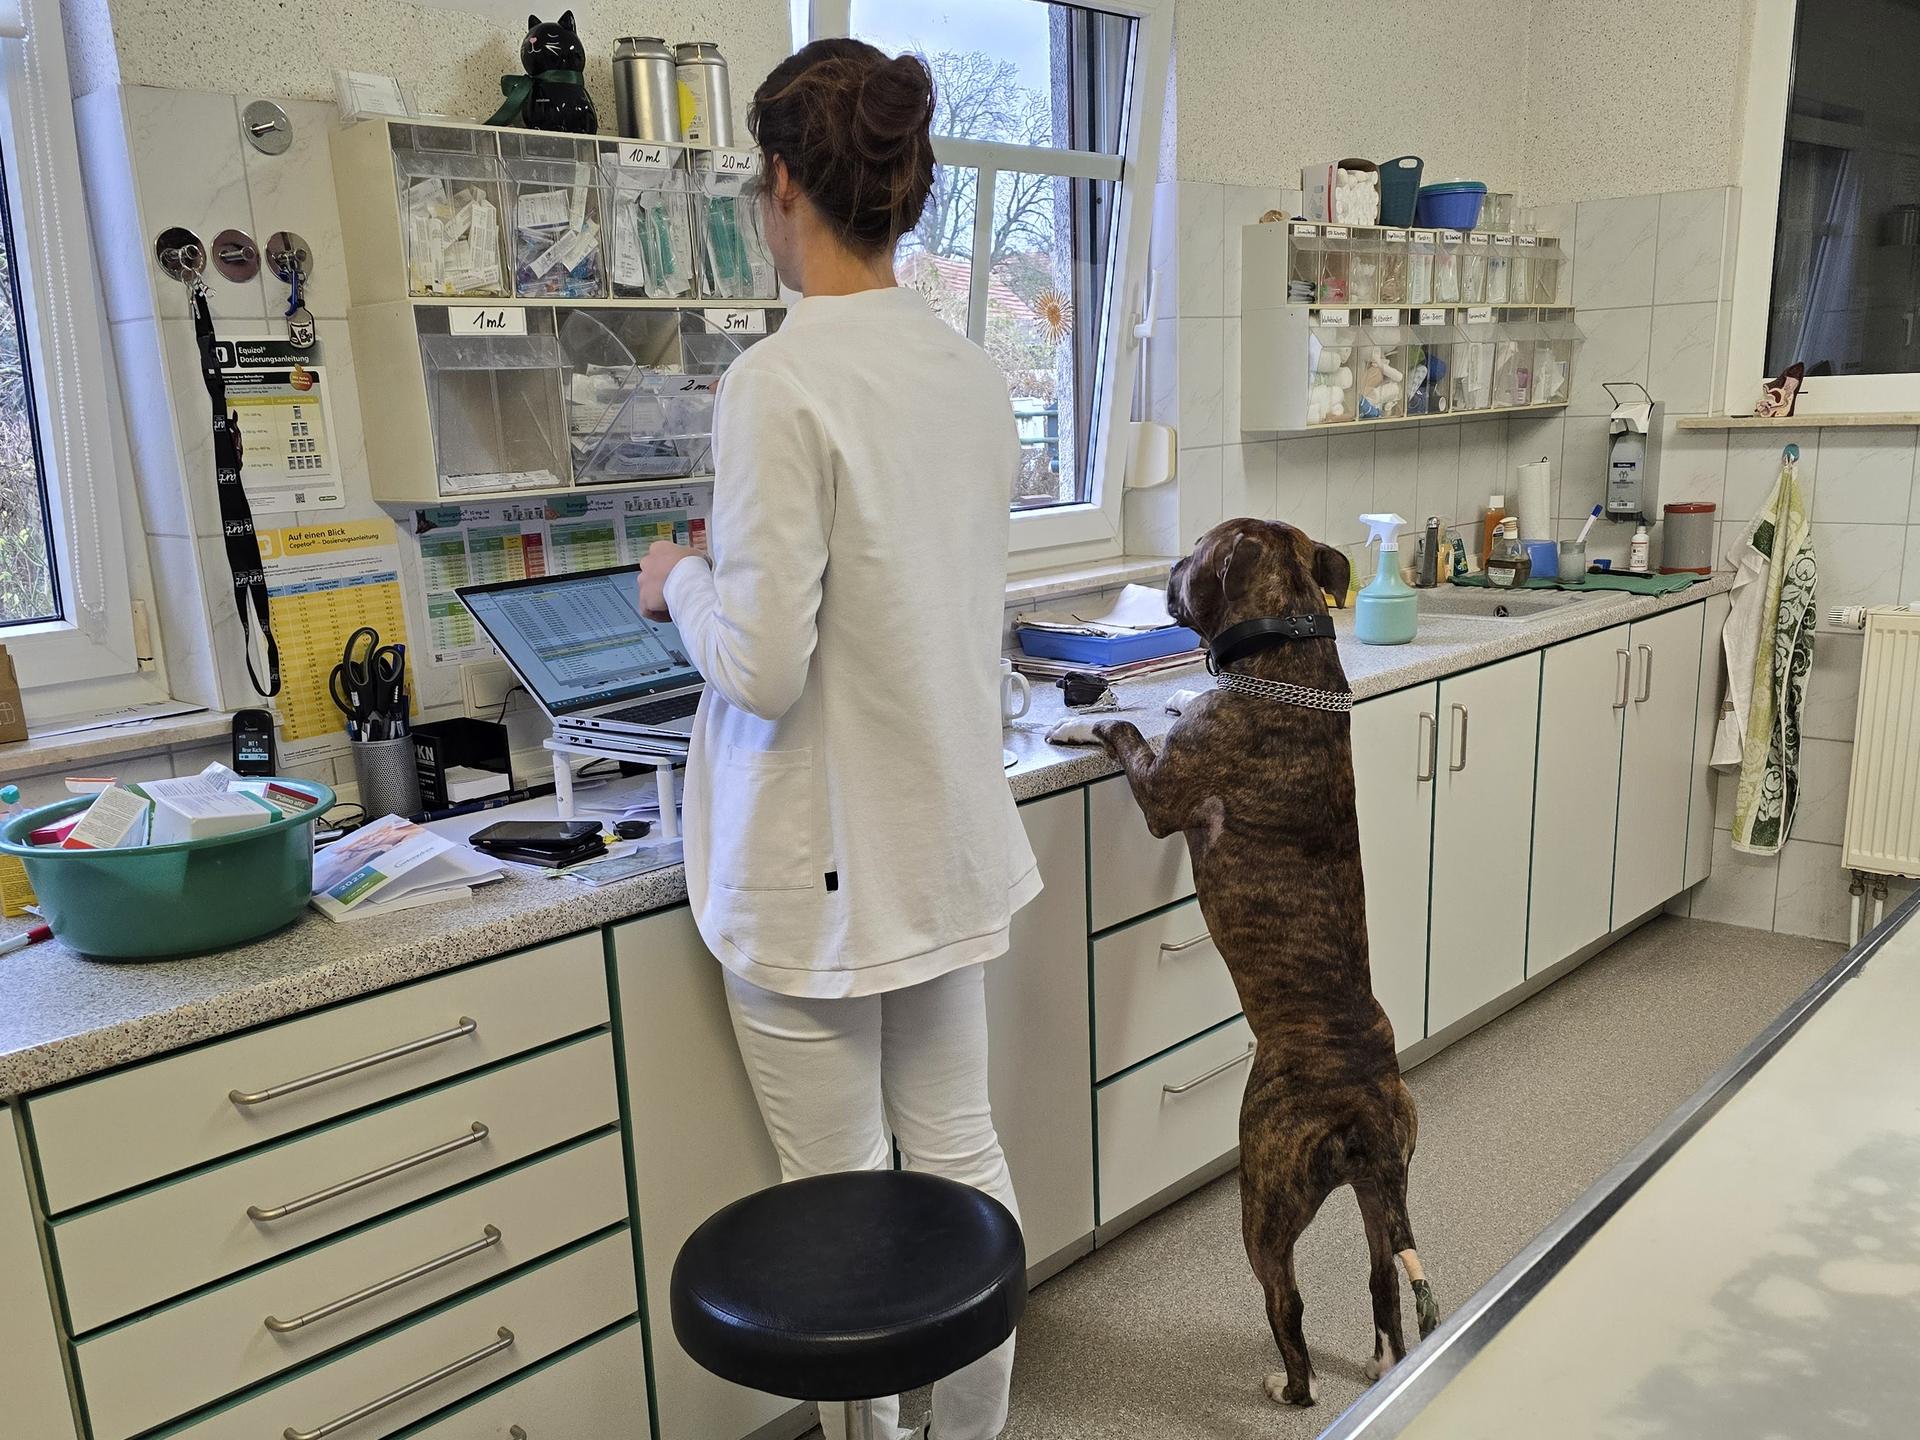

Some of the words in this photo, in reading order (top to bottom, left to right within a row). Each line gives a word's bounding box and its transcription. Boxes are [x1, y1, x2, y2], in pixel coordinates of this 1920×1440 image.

[629, 148, 644, 162] 10
[645, 150, 661, 163] ml
[721, 154, 735, 169] 20
[736, 156, 751, 170] ml
[240, 355, 310, 364] Dosierungsanleitung
[218, 473, 237, 484] art
[225, 525, 244, 535] art
[288, 532, 302, 541] Auf
[304, 530, 326, 539] einen
[327, 528, 346, 537] Blick
[322, 533, 379, 545] Dosierungsanleitung
[235, 576, 248, 587] art
[248, 574, 263, 585] art
